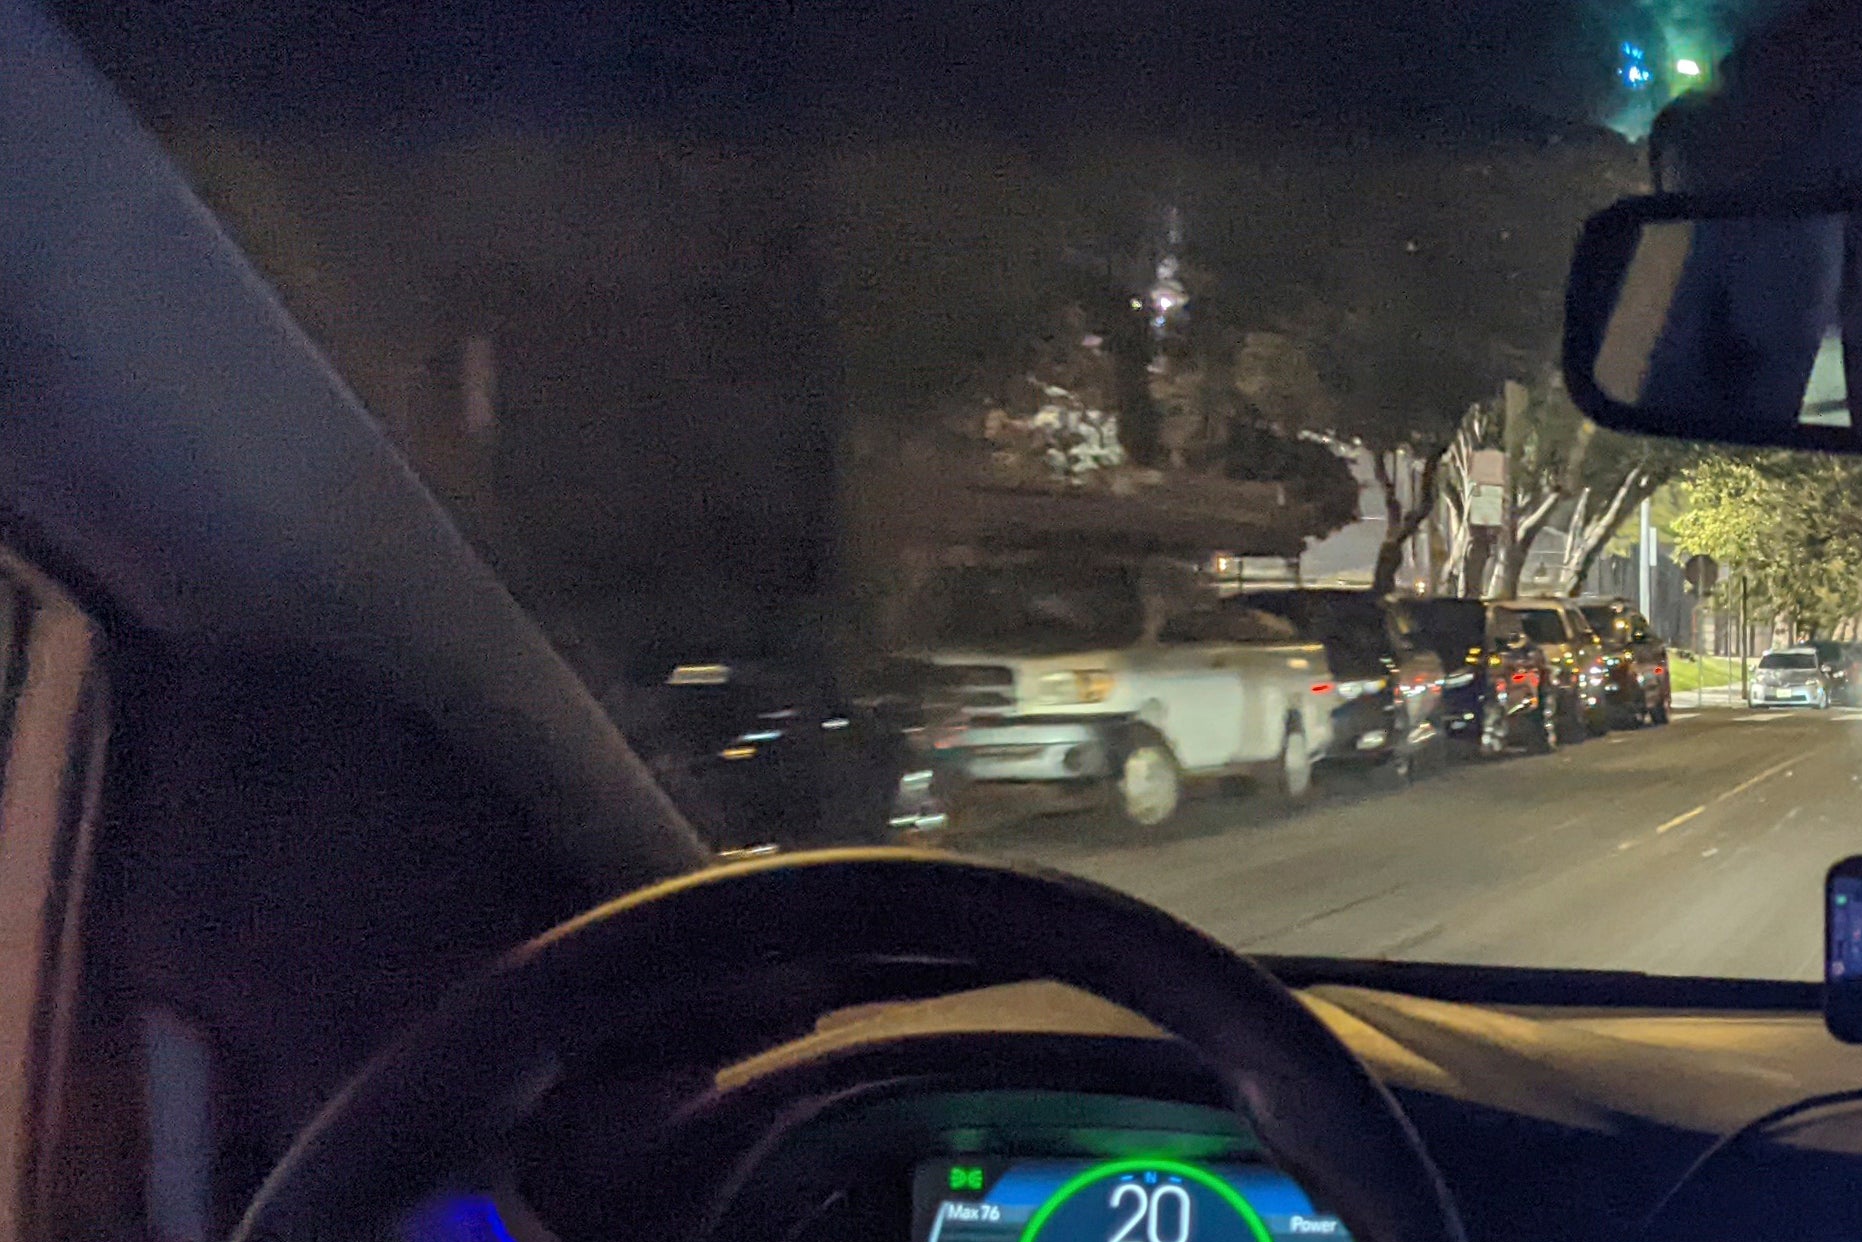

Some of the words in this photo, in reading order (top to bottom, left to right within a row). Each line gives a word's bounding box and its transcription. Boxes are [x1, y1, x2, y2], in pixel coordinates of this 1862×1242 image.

[947, 1204, 980, 1220] Max
[980, 1205, 1001, 1221] 76
[1290, 1215, 1338, 1232] Power
